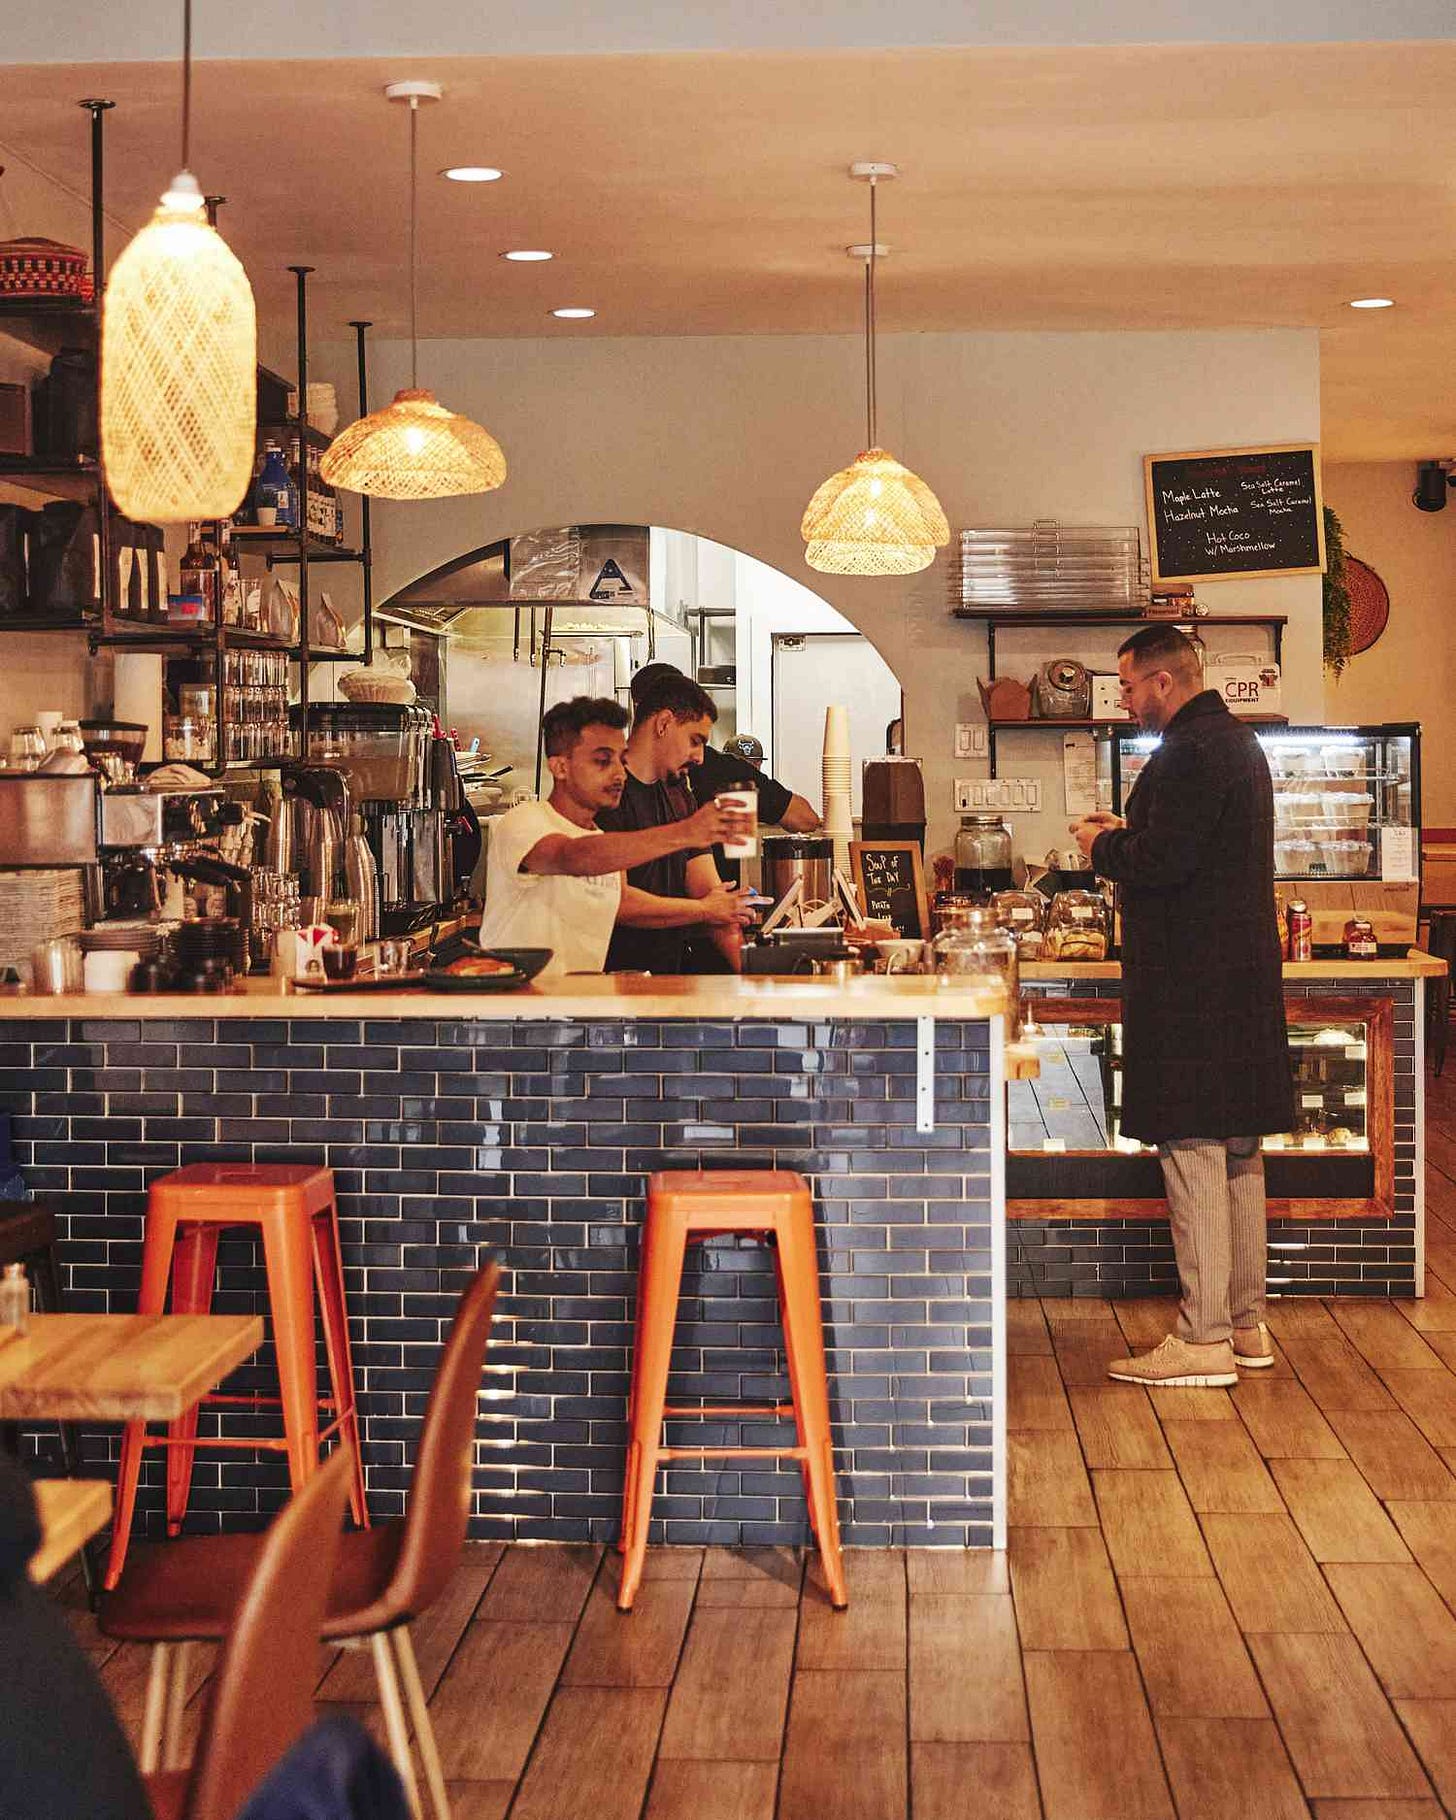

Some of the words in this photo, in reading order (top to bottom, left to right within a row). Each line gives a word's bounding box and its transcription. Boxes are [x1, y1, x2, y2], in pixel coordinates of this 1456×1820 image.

[1240, 481, 1256, 490] Sea
[1256, 480, 1272, 488] Salt
[1273, 478, 1301, 487] Caramel
[1162, 490, 1193, 505] Maple
[1191, 488, 1222, 499] Latte
[1261, 487, 1285, 495] Latte
[1250, 500, 1265, 509] Sea
[1266, 499, 1284, 507] Salt
[1286, 497, 1312, 506] Caramel
[1164, 507, 1205, 524] Hazelnut
[1209, 504, 1239, 517] Mocha
[1268, 507, 1293, 516] Mocha
[1206, 532, 1227, 545] Hot
[1228, 530, 1251, 541] Coco
[1219, 542, 1276, 554] Marshmellow
[1225, 681, 1259, 697] CPR
